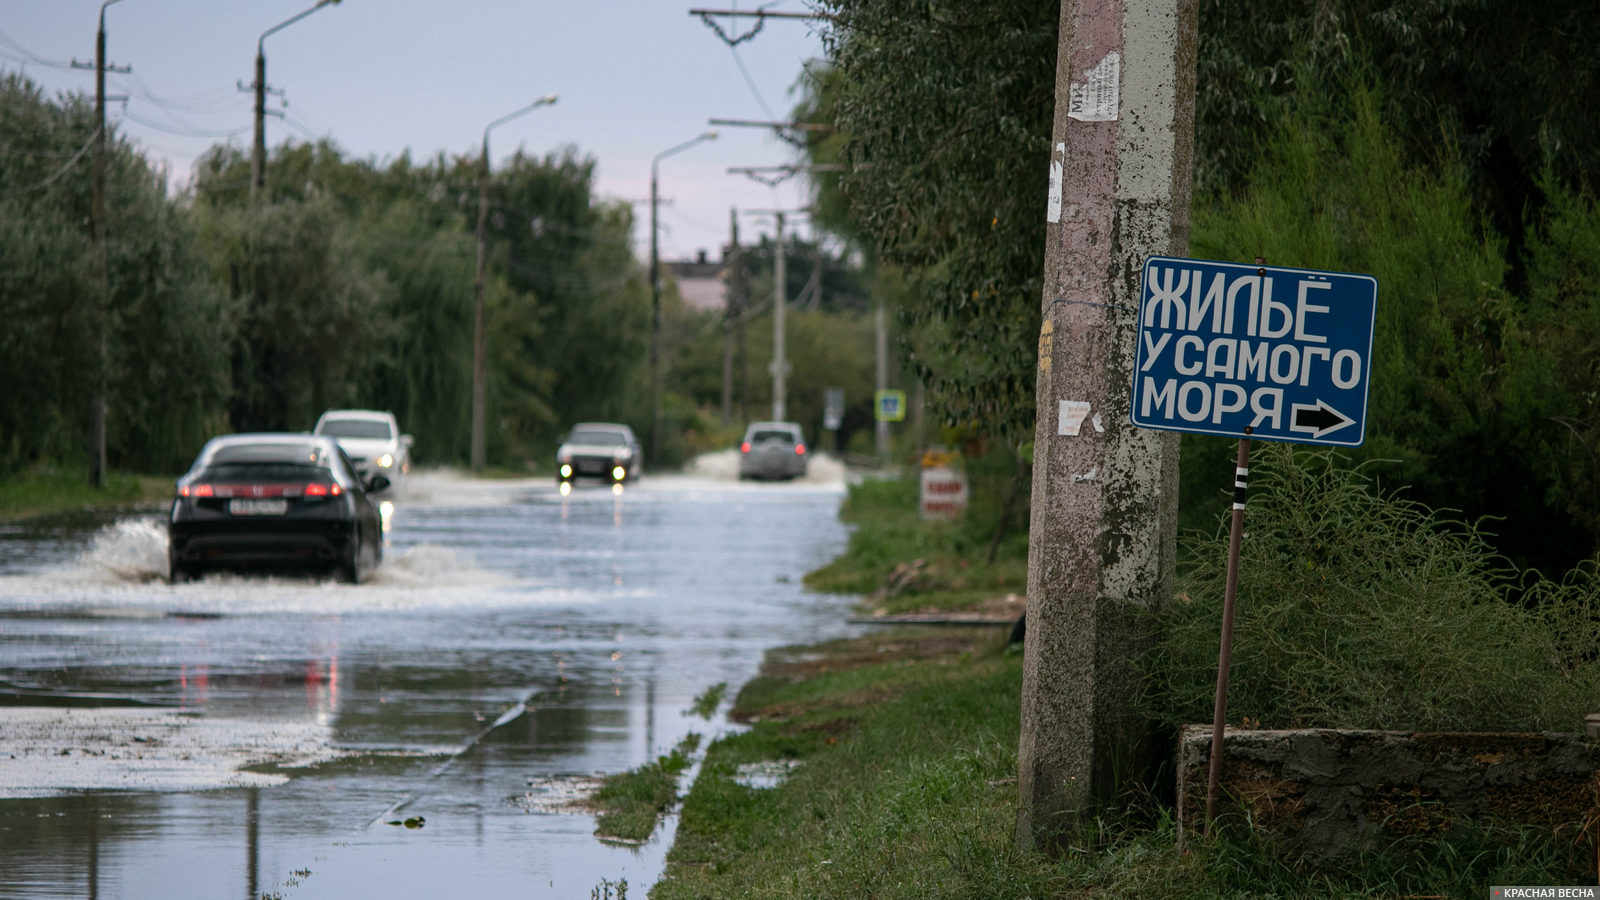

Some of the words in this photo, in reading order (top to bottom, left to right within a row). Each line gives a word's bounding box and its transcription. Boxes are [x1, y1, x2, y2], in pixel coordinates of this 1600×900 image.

[1144, 266, 1332, 343] ЖИЛЬЁ
[1140, 330, 1172, 372] У
[1174, 335, 1362, 390] САМОГО
[1141, 376, 1284, 430] МОРЯ
